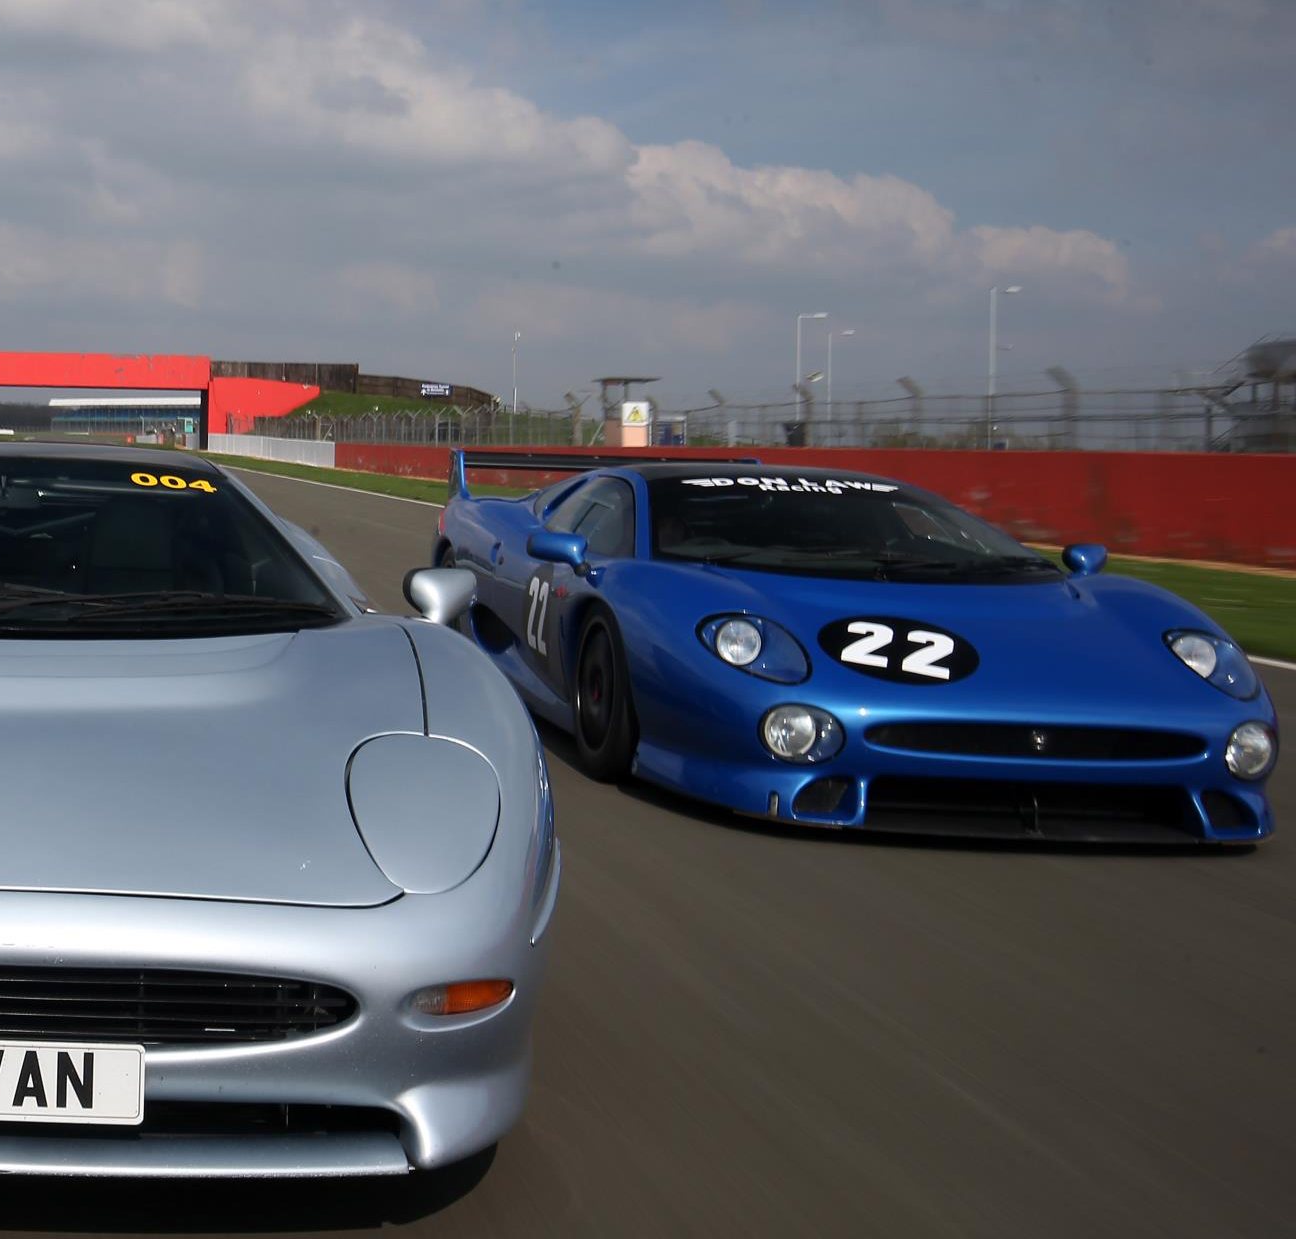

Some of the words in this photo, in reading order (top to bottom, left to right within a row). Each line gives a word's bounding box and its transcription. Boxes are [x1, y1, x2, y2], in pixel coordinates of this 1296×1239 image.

[131, 473, 217, 493] 004
[711, 477, 788, 487] DON
[797, 478, 872, 491] LAW
[759, 484, 843, 495] Racing
[527, 576, 549, 656] 22
[841, 621, 954, 680] 22
